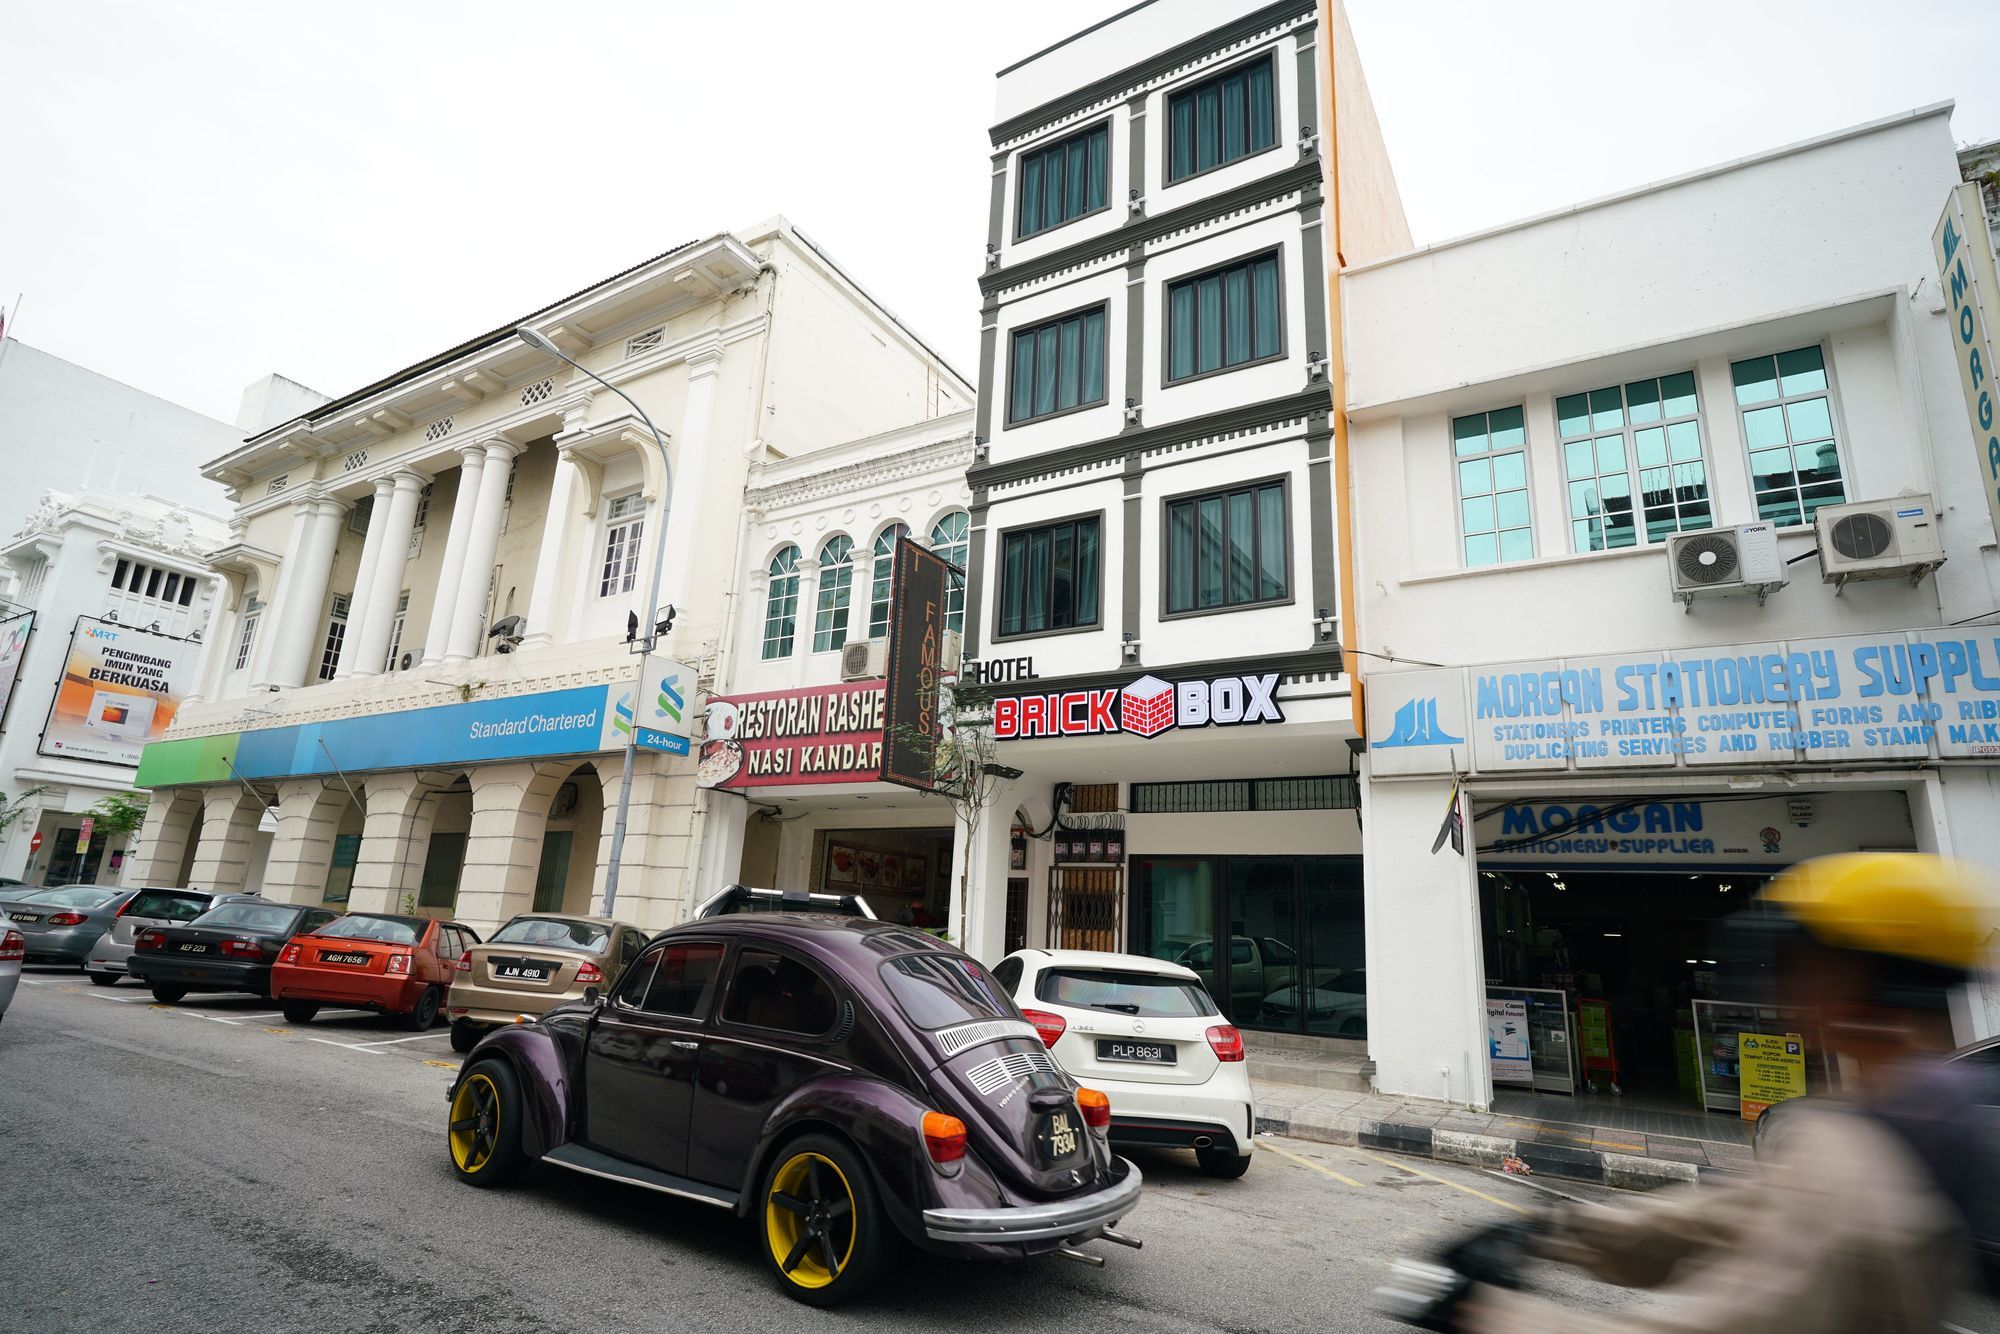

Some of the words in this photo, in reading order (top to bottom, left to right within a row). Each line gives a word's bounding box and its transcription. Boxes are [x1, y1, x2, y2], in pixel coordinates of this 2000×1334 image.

[101, 647, 172, 669] PENGIMBANG
[104, 659, 134, 672] IMUN
[136, 665, 164, 678] YANG
[918, 600, 936, 735] FAMOUS
[977, 656, 1039, 684] HOTEL
[89, 667, 170, 694] BERKUASA
[1477, 667, 1604, 719] MORGAN
[1615, 650, 1841, 711] STATIONERY
[736, 695, 823, 740] RESTORAN
[994, 688, 1120, 739] BRICK
[1177, 673, 1282, 727] BOX
[470, 717, 528, 739] Standard
[528, 708, 597, 733] Chartered
[1493, 721, 1590, 741] STATIONERS
[1600, 717, 1686, 736] PRINTERS
[1697, 711, 1799, 731] COMPUTER
[1811, 705, 1883, 726] FORMS
[1897, 702, 1943, 722] AND
[647, 734, 682, 750] 24-hour
[1504, 740, 1609, 760] DUPLICATING
[1618, 736, 1707, 755] SERVICES
[1719, 734, 1757, 752] AND
[1768, 729, 1851, 751] RUBBER
[1863, 725, 1935, 746] STAMP
[748, 748, 793, 775] NASI
[800, 742, 882, 772] KANDAR
[1502, 802, 1704, 834] MORGAN
[1494, 839, 1610, 854] STATIONERY
[1616, 839, 1715, 854] SUPPLIER
[179, 943, 193, 951] AEF
[192, 945, 207, 953] 223
[326, 954, 344, 962] AGH
[342, 955, 363, 964] 7656
[504, 967, 520, 976] AJN
[522, 969, 541, 978] 4910
[1112, 1045, 1135, 1057] PLP
[1136, 1046, 1162, 1059] 8631
[1787, 1043, 1798, 1053] P
[1052, 1113, 1072, 1135] BAL
[1050, 1132, 1076, 1157] 7934
